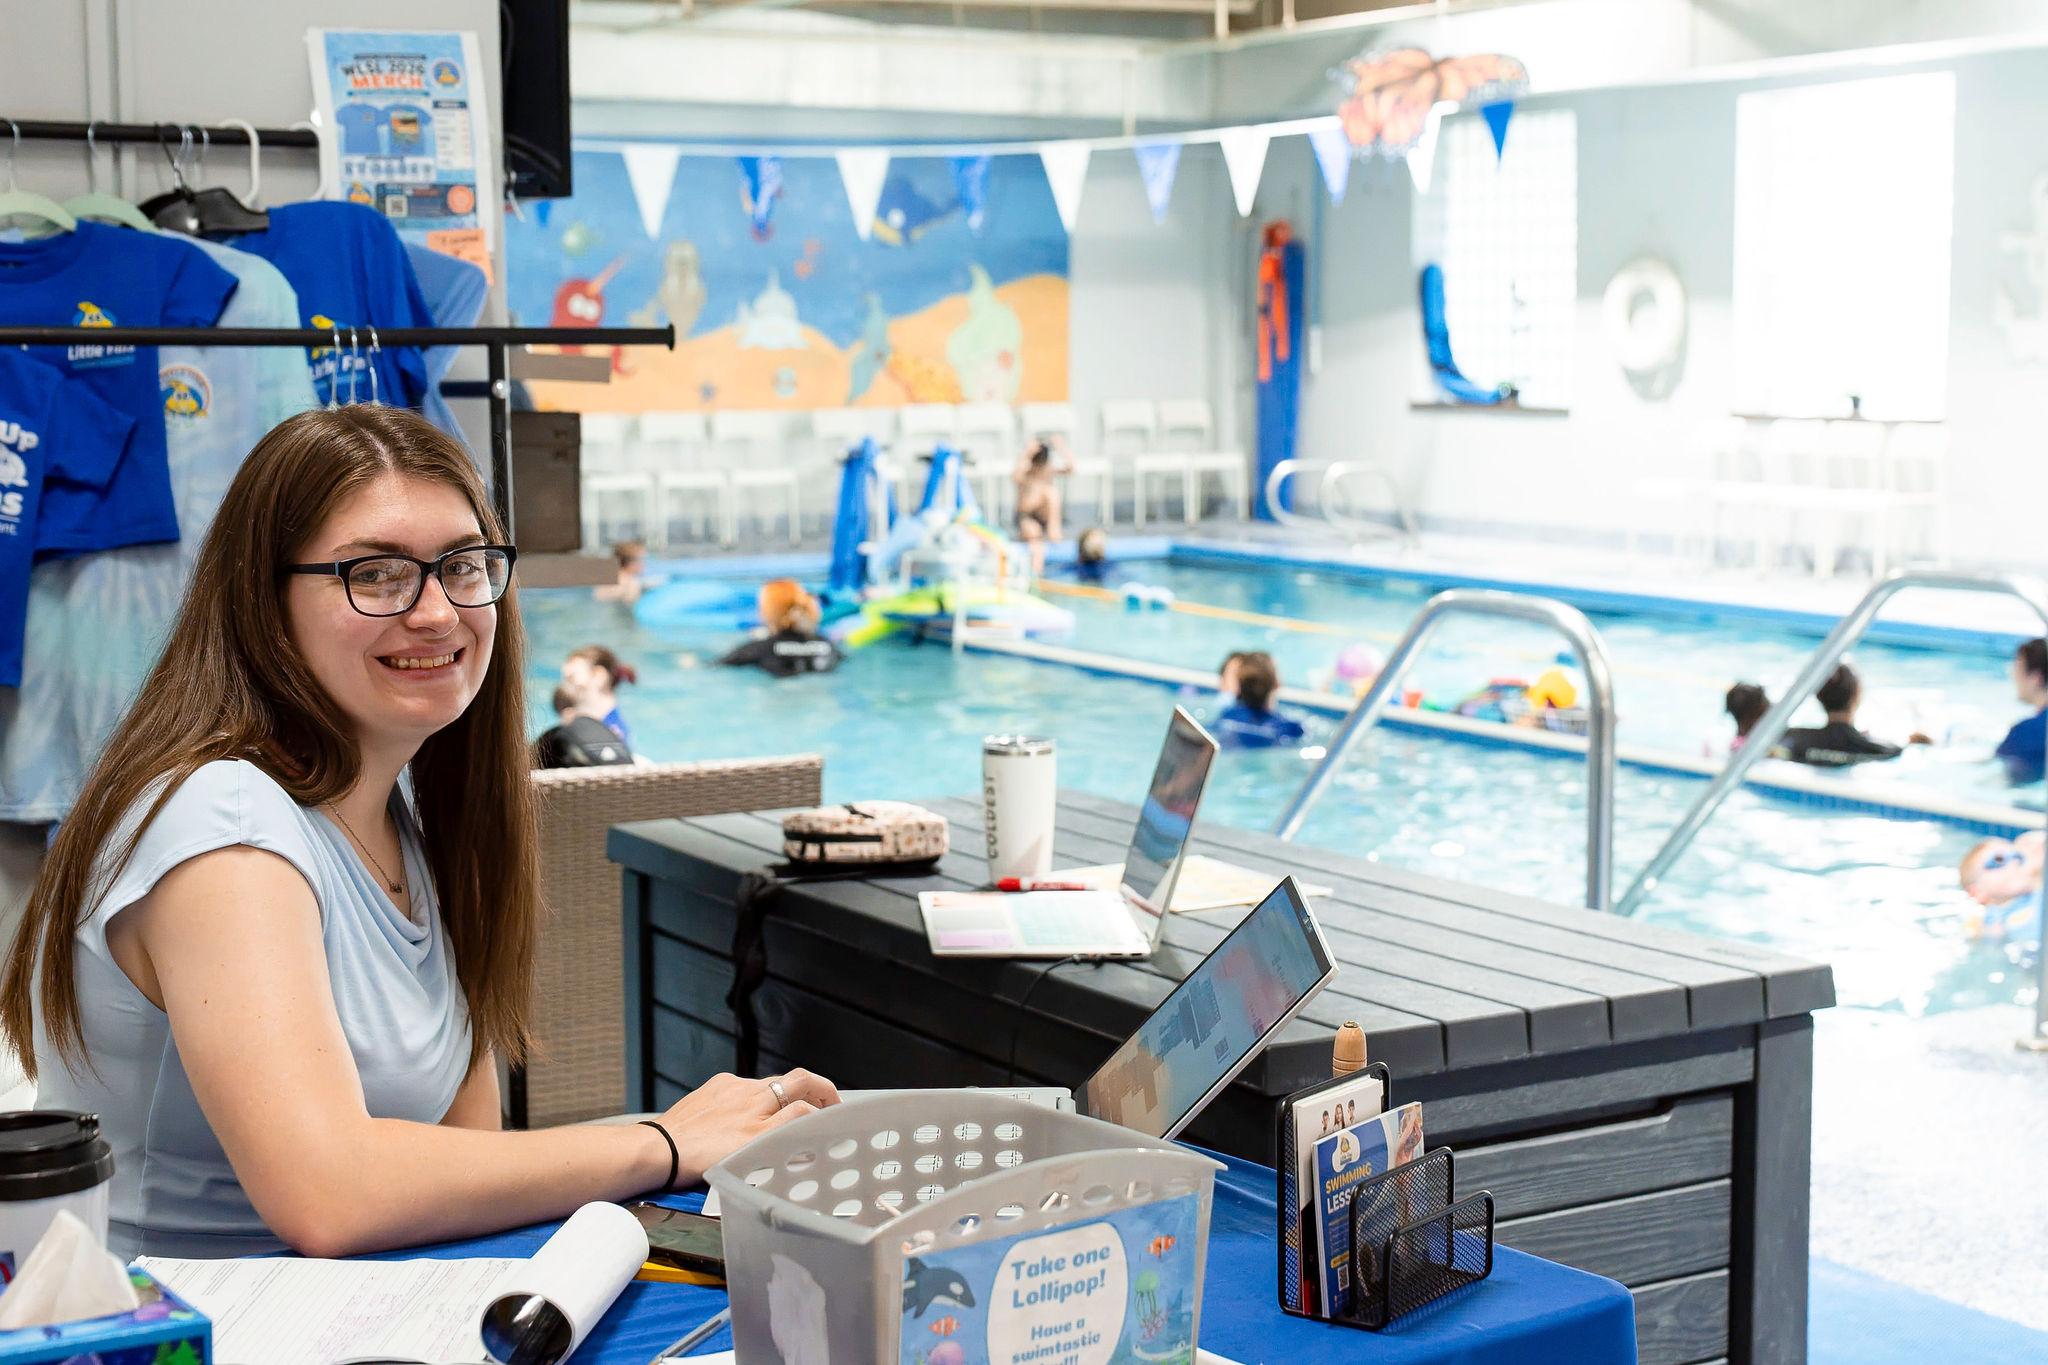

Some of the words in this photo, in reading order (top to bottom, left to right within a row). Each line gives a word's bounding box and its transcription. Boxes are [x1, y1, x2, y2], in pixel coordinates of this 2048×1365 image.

[352, 73, 423, 89] MERCH
[985, 776, 999, 860] COLDEST
[1325, 1162, 1373, 1195] SWIMMING
[1011, 1255, 1066, 1280] Take
[1072, 1246, 1110, 1267] one
[1012, 1268, 1106, 1308] Lollipop!
[1031, 1322, 1072, 1341] Have
[1076, 1318, 1085, 1329] a
[1012, 1331, 1101, 1364] swimtastic
